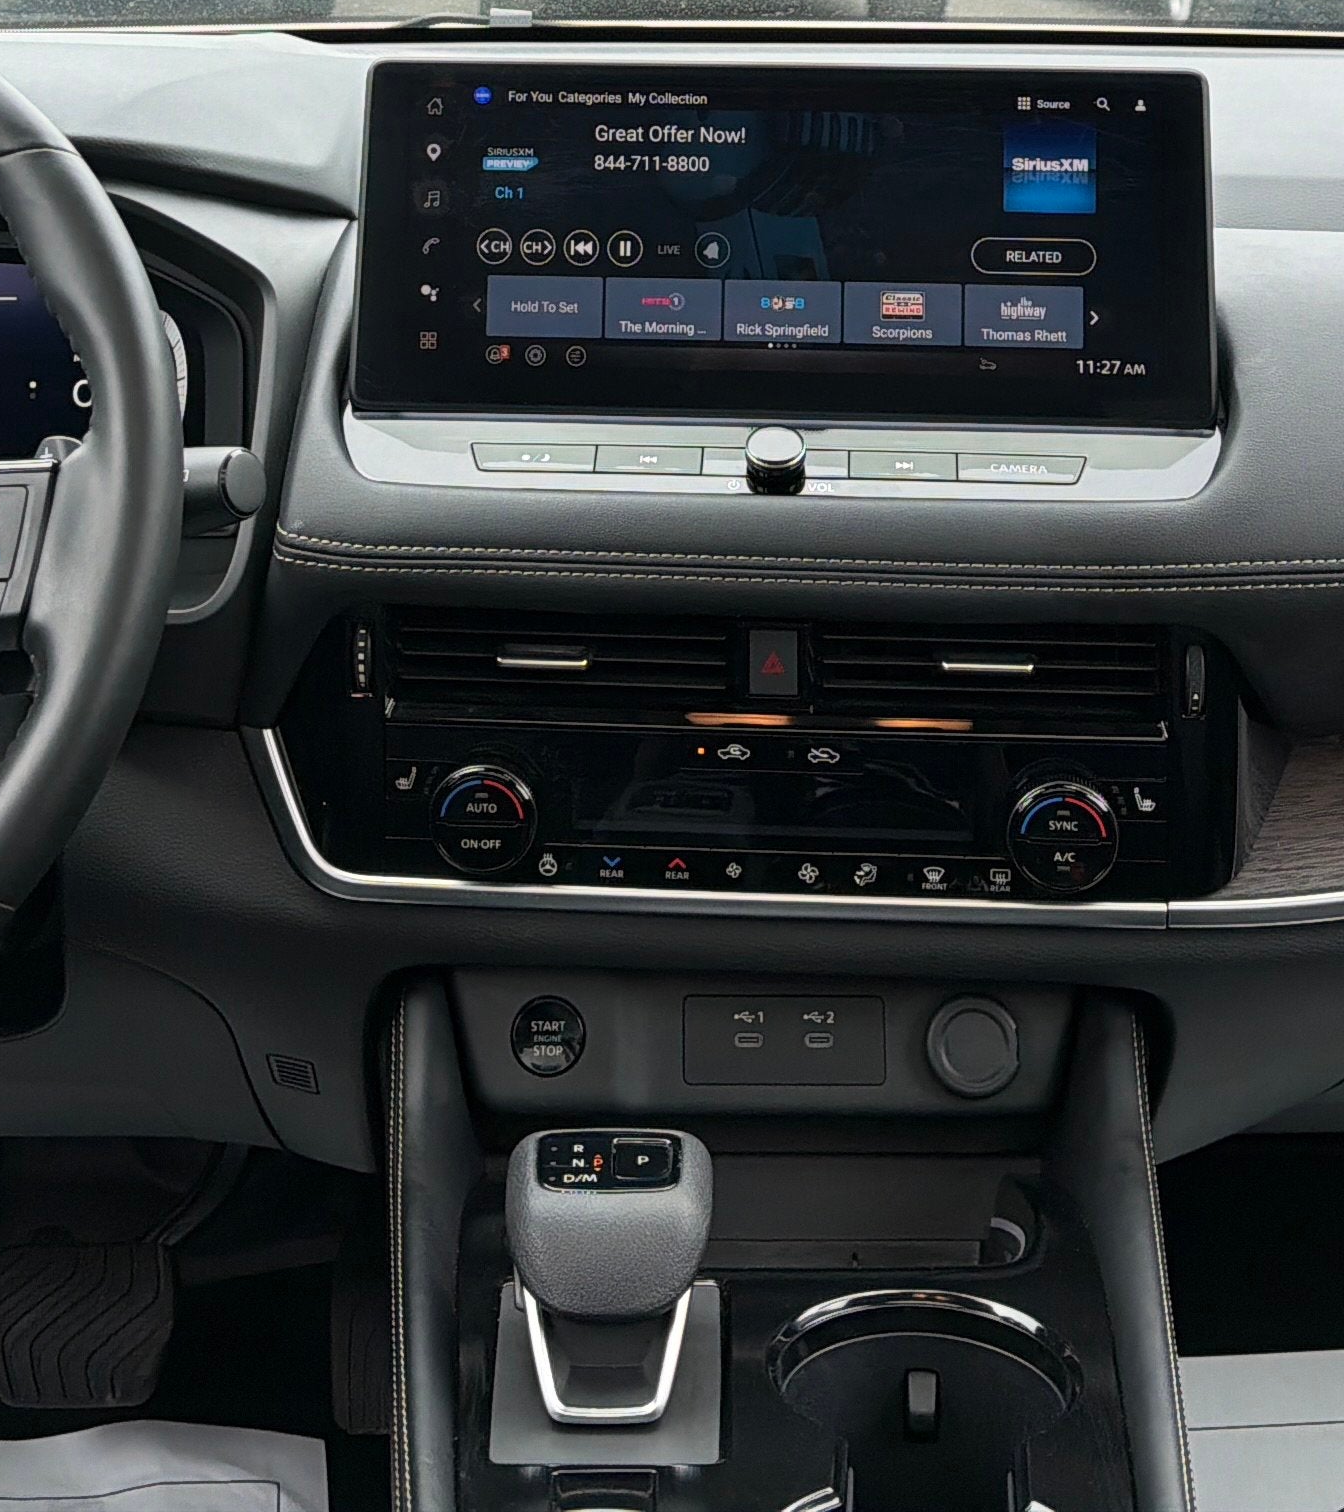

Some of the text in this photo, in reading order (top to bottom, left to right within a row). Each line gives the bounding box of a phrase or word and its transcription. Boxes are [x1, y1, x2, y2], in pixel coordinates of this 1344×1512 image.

[508, 91, 708, 105] For You Categories My Collection
[1037, 99, 1071, 110] Source
[595, 125, 746, 144] Great Offer Now!
[487, 147, 534, 156] SIRIUSXM
[594, 155, 710, 172] 844-711-8800
[1011, 157, 1089, 172] SiriusXM
[495, 187, 524, 199] Ch 1
[657, 245, 681, 256] LIVE
[1006, 250, 1062, 264] RELATED
[885, 293, 921, 302] Classic
[1021, 297, 1032, 307] the
[511, 301, 578, 314] Hold To Set
[884, 307, 922, 315] REWIND
[1000, 302, 1047, 320] highway
[619, 321, 643, 334] The
[645, 322, 695, 336] Morning
[736, 323, 829, 339] Rick Springfield
[872, 326, 933, 340] Scorpions
[981, 328, 1067, 342] Thomas Rhett
[1076, 359, 1146, 375] 11:27 AM
[990, 463, 1048, 474] CAMERA
[808, 482, 835, 493] VOL
[466, 802, 498, 814] AUTO
[1048, 821, 1079, 831] SYNC
[1053, 852, 1076, 863] A/C
[599, 869, 624, 878] REAR
[664, 871, 690, 880] REAR
[921, 882, 947, 891] FRONT
[989, 884, 1011, 892] REAR
[757, 1011, 764, 1024] 1
[826, 1011, 835, 1024] 2
[530, 1020, 566, 1032] START
[533, 1035, 562, 1043] ENGINE
[533, 1045, 564, 1057] STOP
[573, 1144, 585, 1153] R
[572, 1158, 585, 1168] N
[637, 1155, 650, 1166] P
[563, 1173, 598, 1183] D/M
